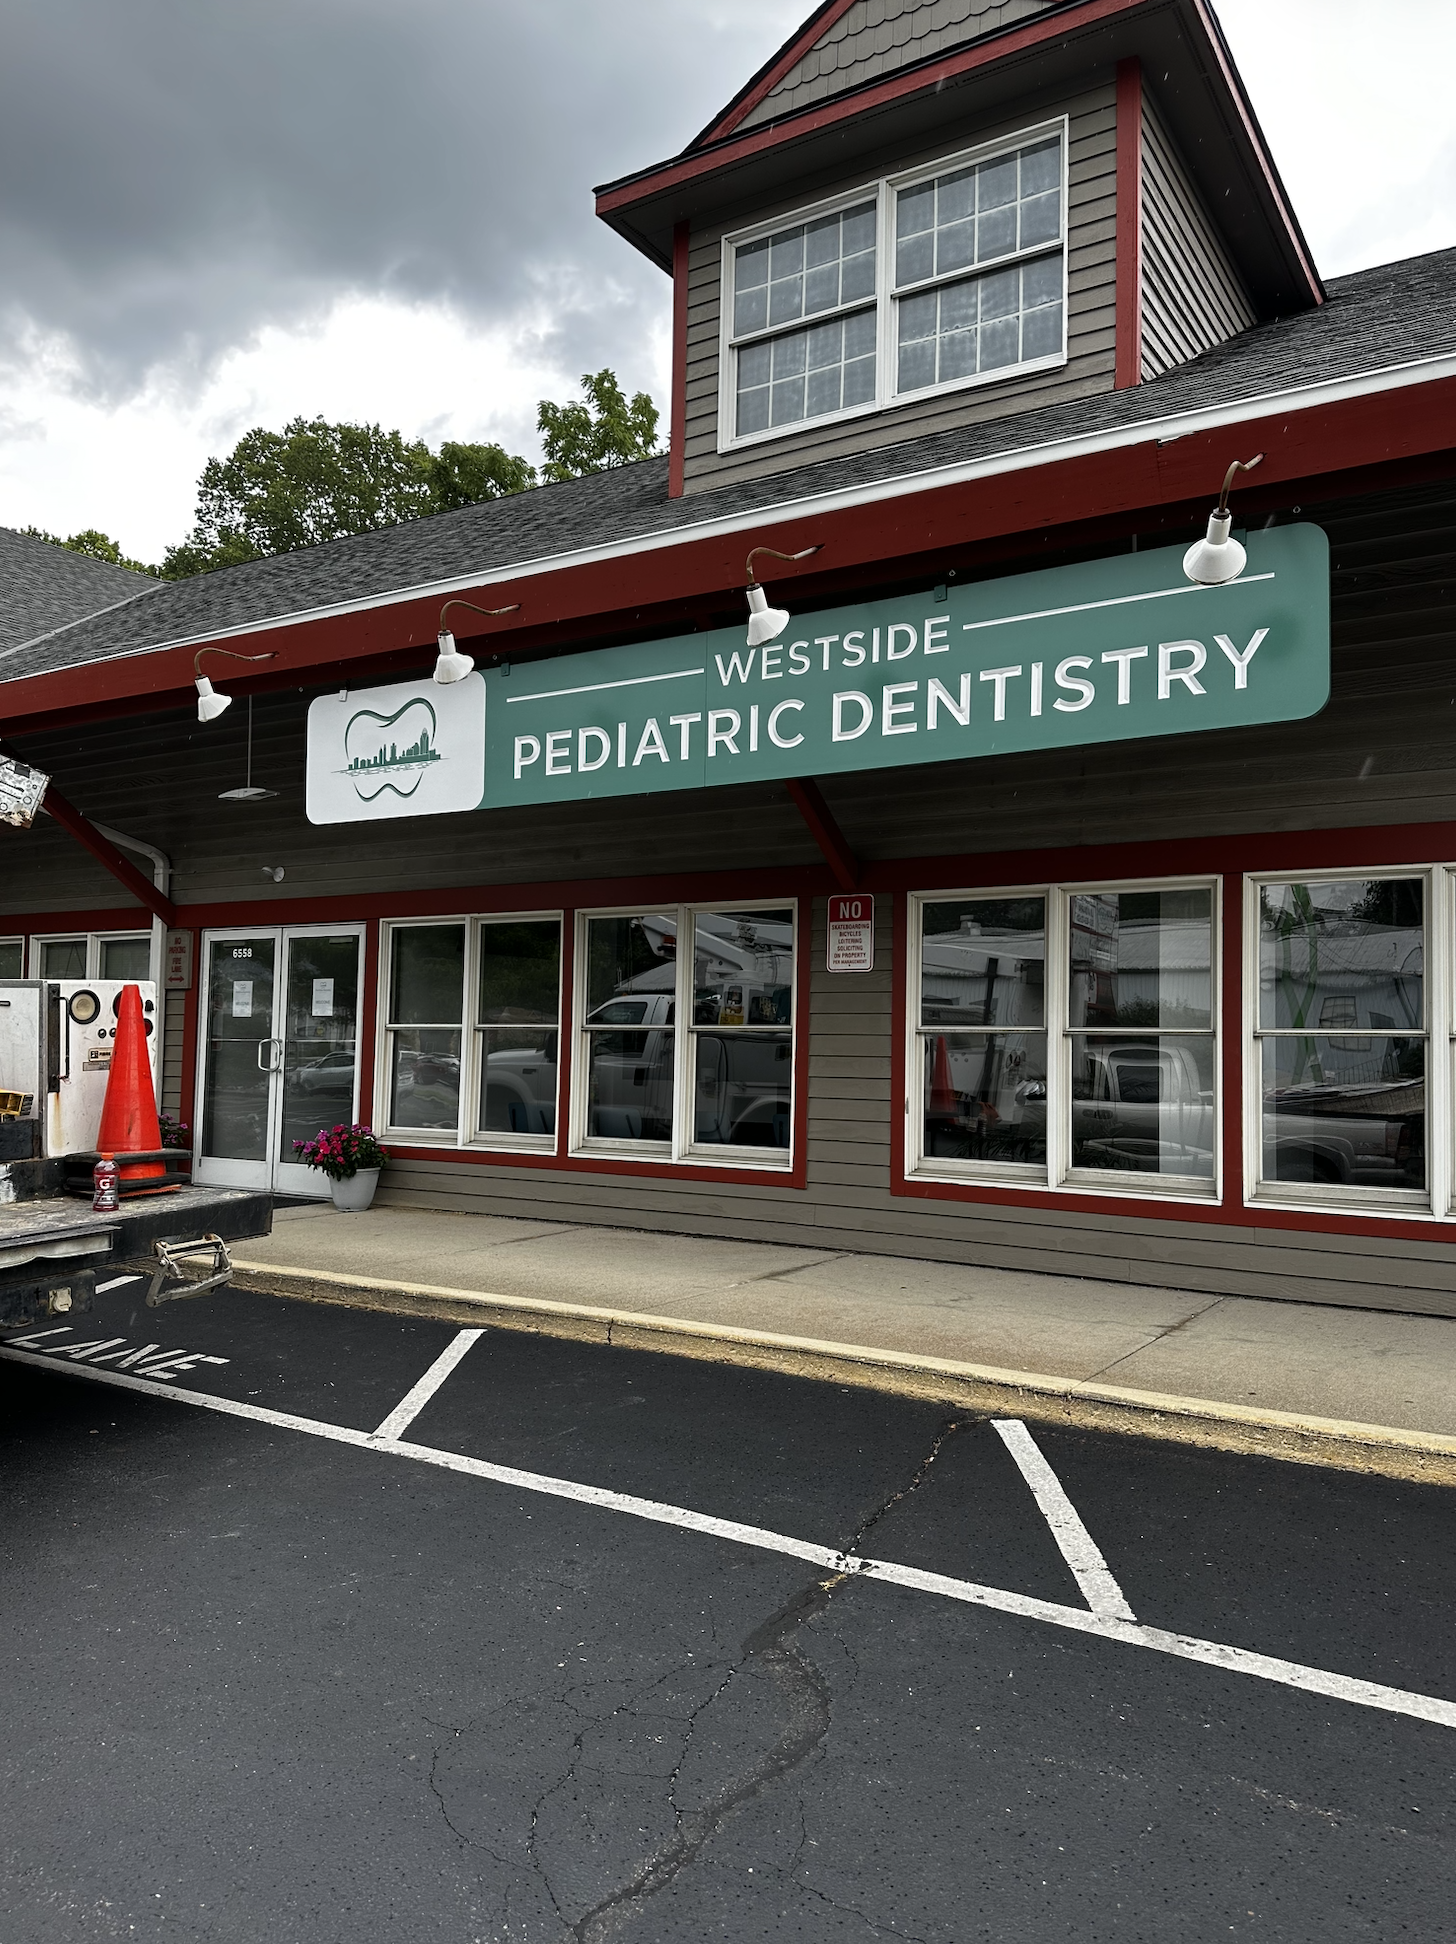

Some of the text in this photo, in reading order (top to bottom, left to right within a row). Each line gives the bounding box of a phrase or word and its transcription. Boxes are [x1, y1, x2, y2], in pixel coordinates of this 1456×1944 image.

[714, 614, 950, 687] WESTSIDE
[513, 627, 1271, 780] PEDIATRIC DENTISTRY
[840, 901, 862, 919] NO
[174, 937, 182, 945] NO
[168, 946, 186, 954] PARKING
[232, 947, 253, 959] 6558
[172, 957, 182, 965] FIRE
[171, 965, 182, 973] LANE
[99, 1178, 110, 1190] G
[3, 1326, 231, 1379] LANE
